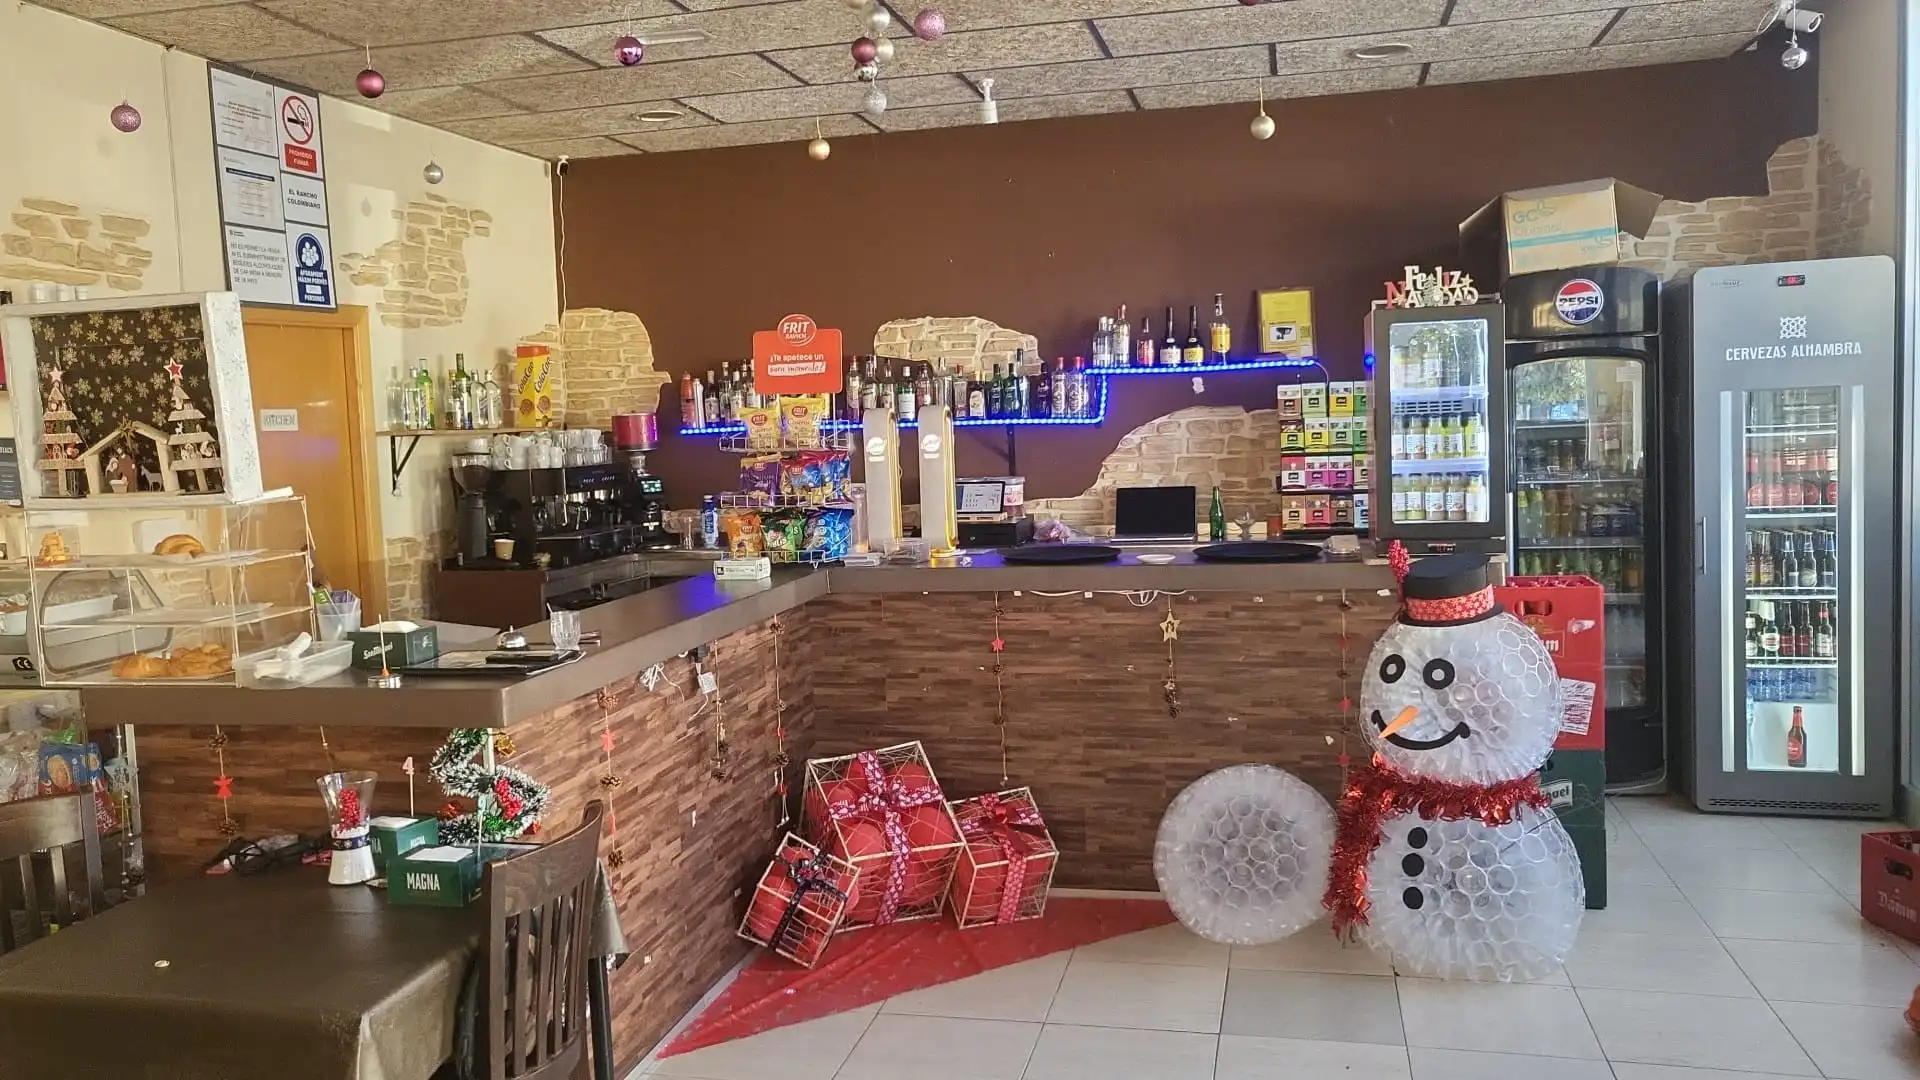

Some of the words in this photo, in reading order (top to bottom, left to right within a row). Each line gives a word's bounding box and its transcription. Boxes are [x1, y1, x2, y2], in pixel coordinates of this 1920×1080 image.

[296, 190, 318, 200] RANCHO
[287, 197, 321, 209] COLOMBIANO
[1559, 296, 1599, 307] PEPSI
[782, 321, 811, 334] FRIT
[785, 333, 807, 341] RAVICH
[1726, 345, 1787, 361] CERVEZAS
[1791, 341, 1862, 358] ALHAMBRA
[782, 354, 813, 362] apetece
[402, 757, 414, 775] 4
[406, 872, 441, 891] MAGNA
